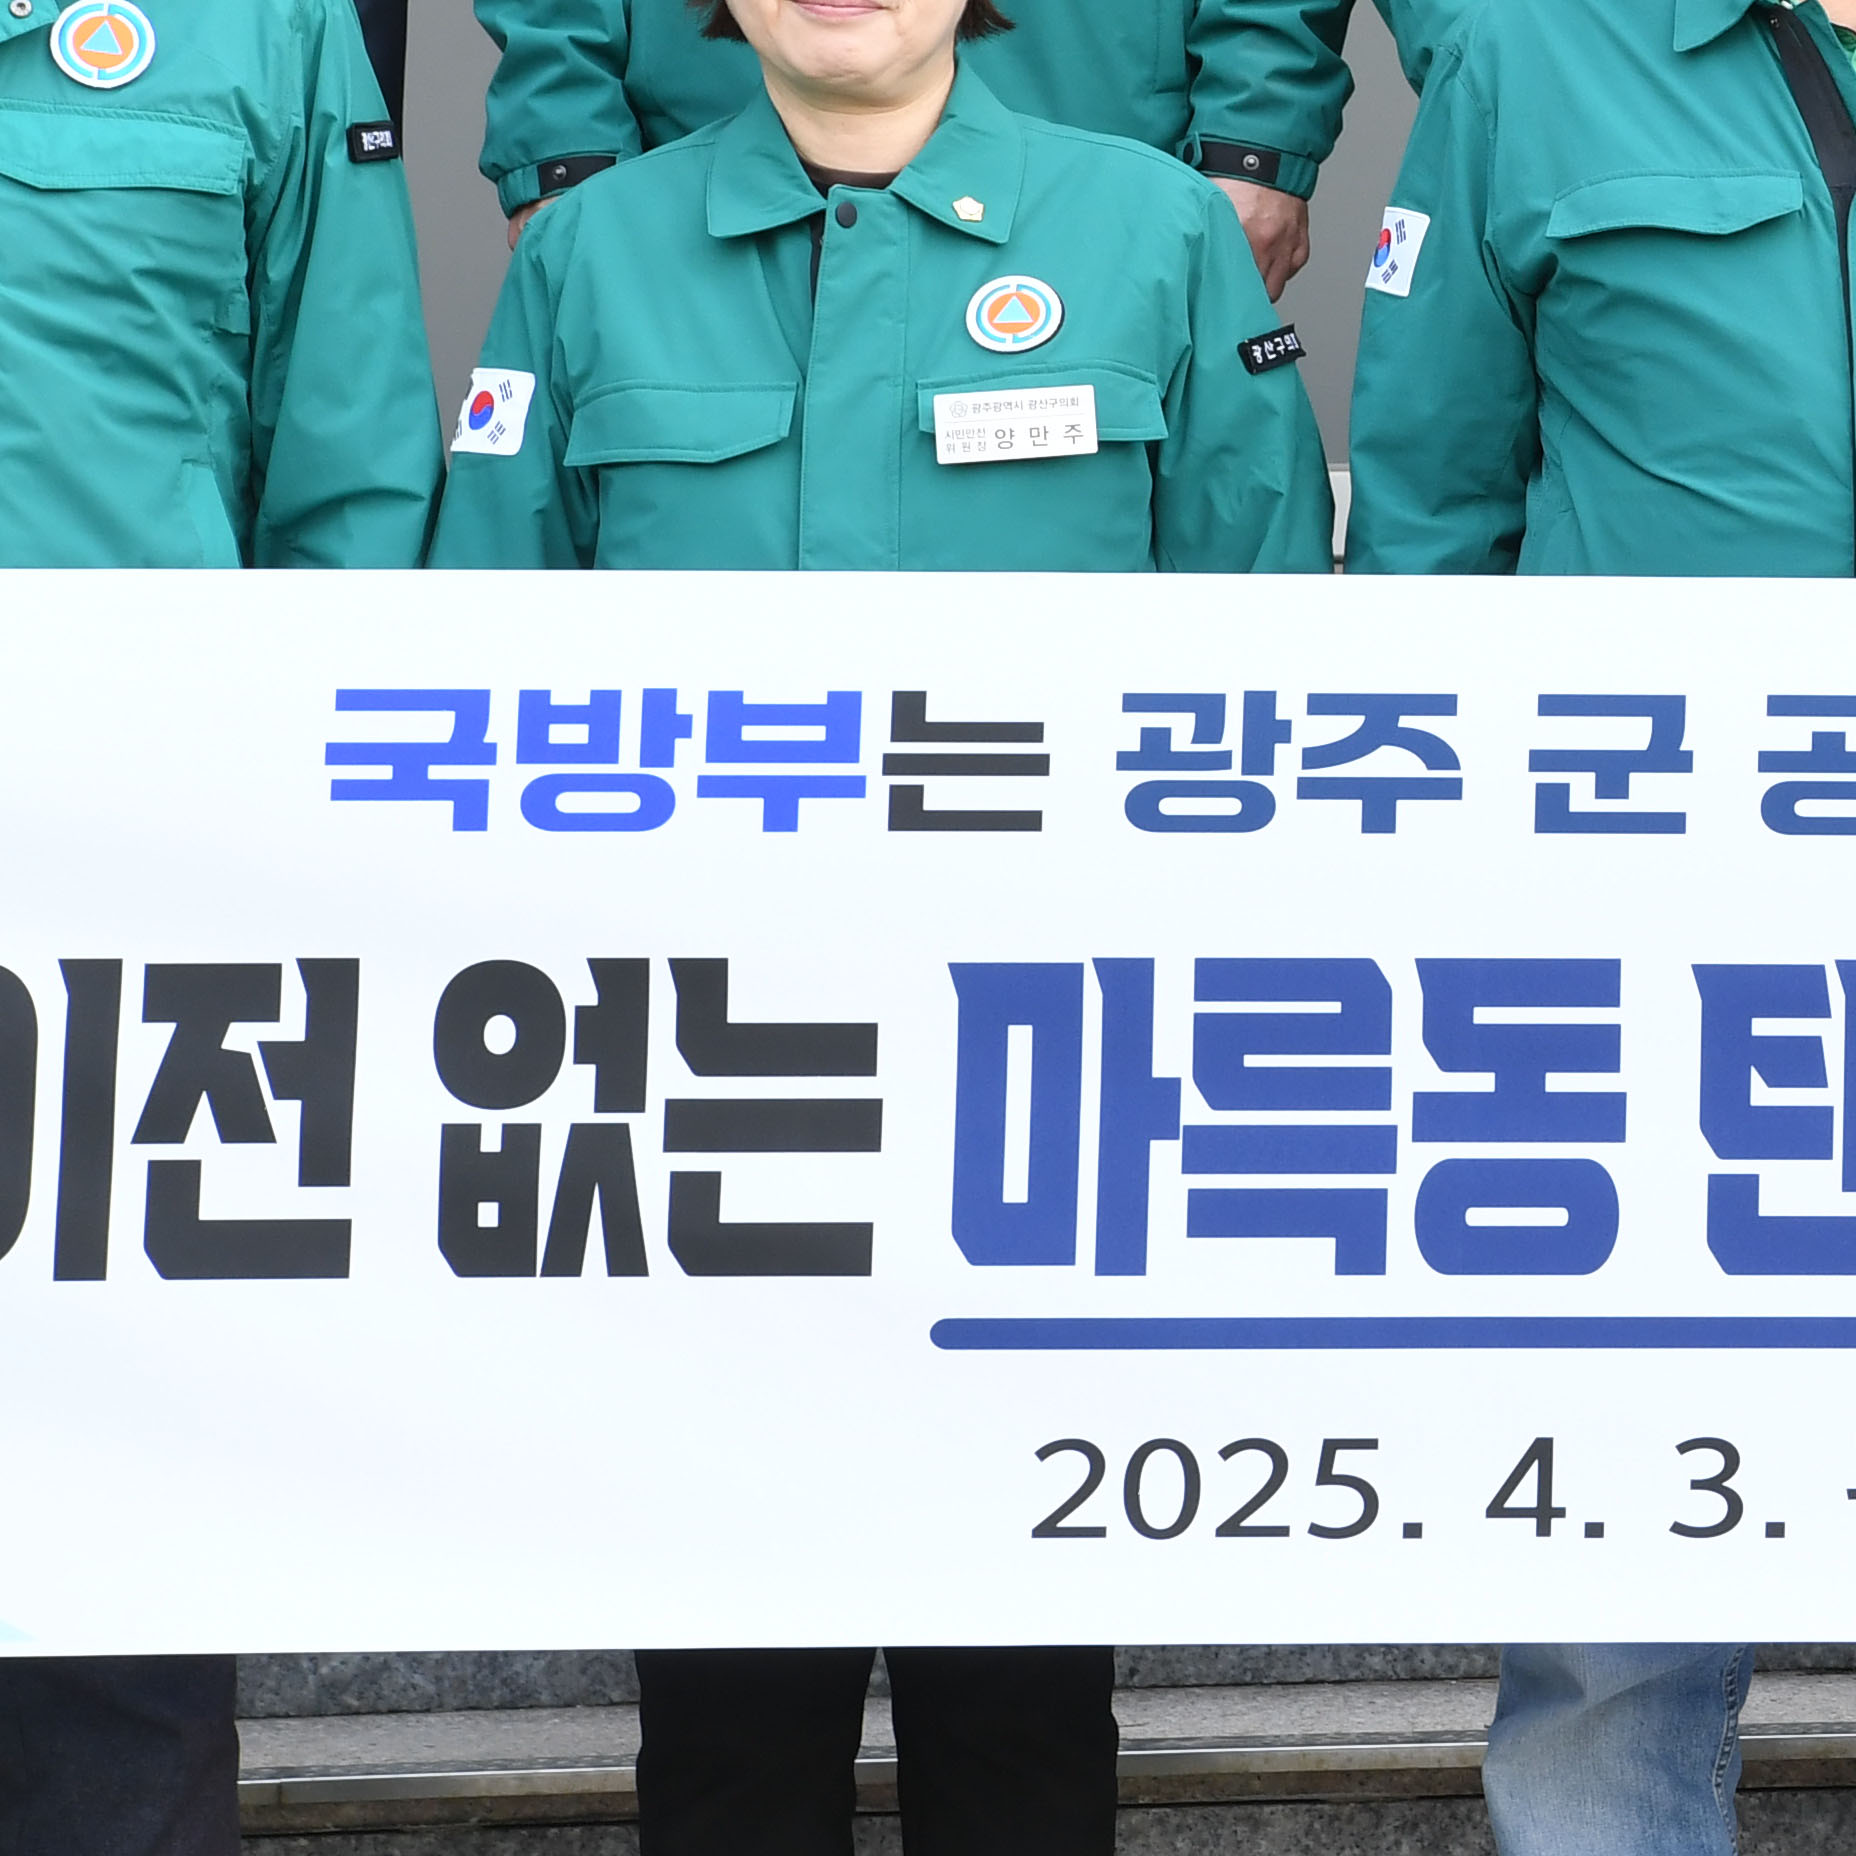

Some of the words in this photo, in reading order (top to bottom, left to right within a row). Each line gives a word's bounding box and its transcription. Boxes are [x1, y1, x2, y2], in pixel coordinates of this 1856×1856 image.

[971, 399, 1024, 415] 광주광역시
[1028, 396, 1080, 411] 광산구의회
[325, 688, 1050, 833] 국방부는
[1116, 691, 1463, 834] 광주
[1529, 694, 1693, 835] 군
[433, 958, 883, 1278] 없는
[948, 958, 1627, 1277] 마륵동
[1032, 1438, 1422, 1540] 2025.
[1486, 1437, 1604, 1539] 4.
[1670, 1437, 1785, 1539] 3.
